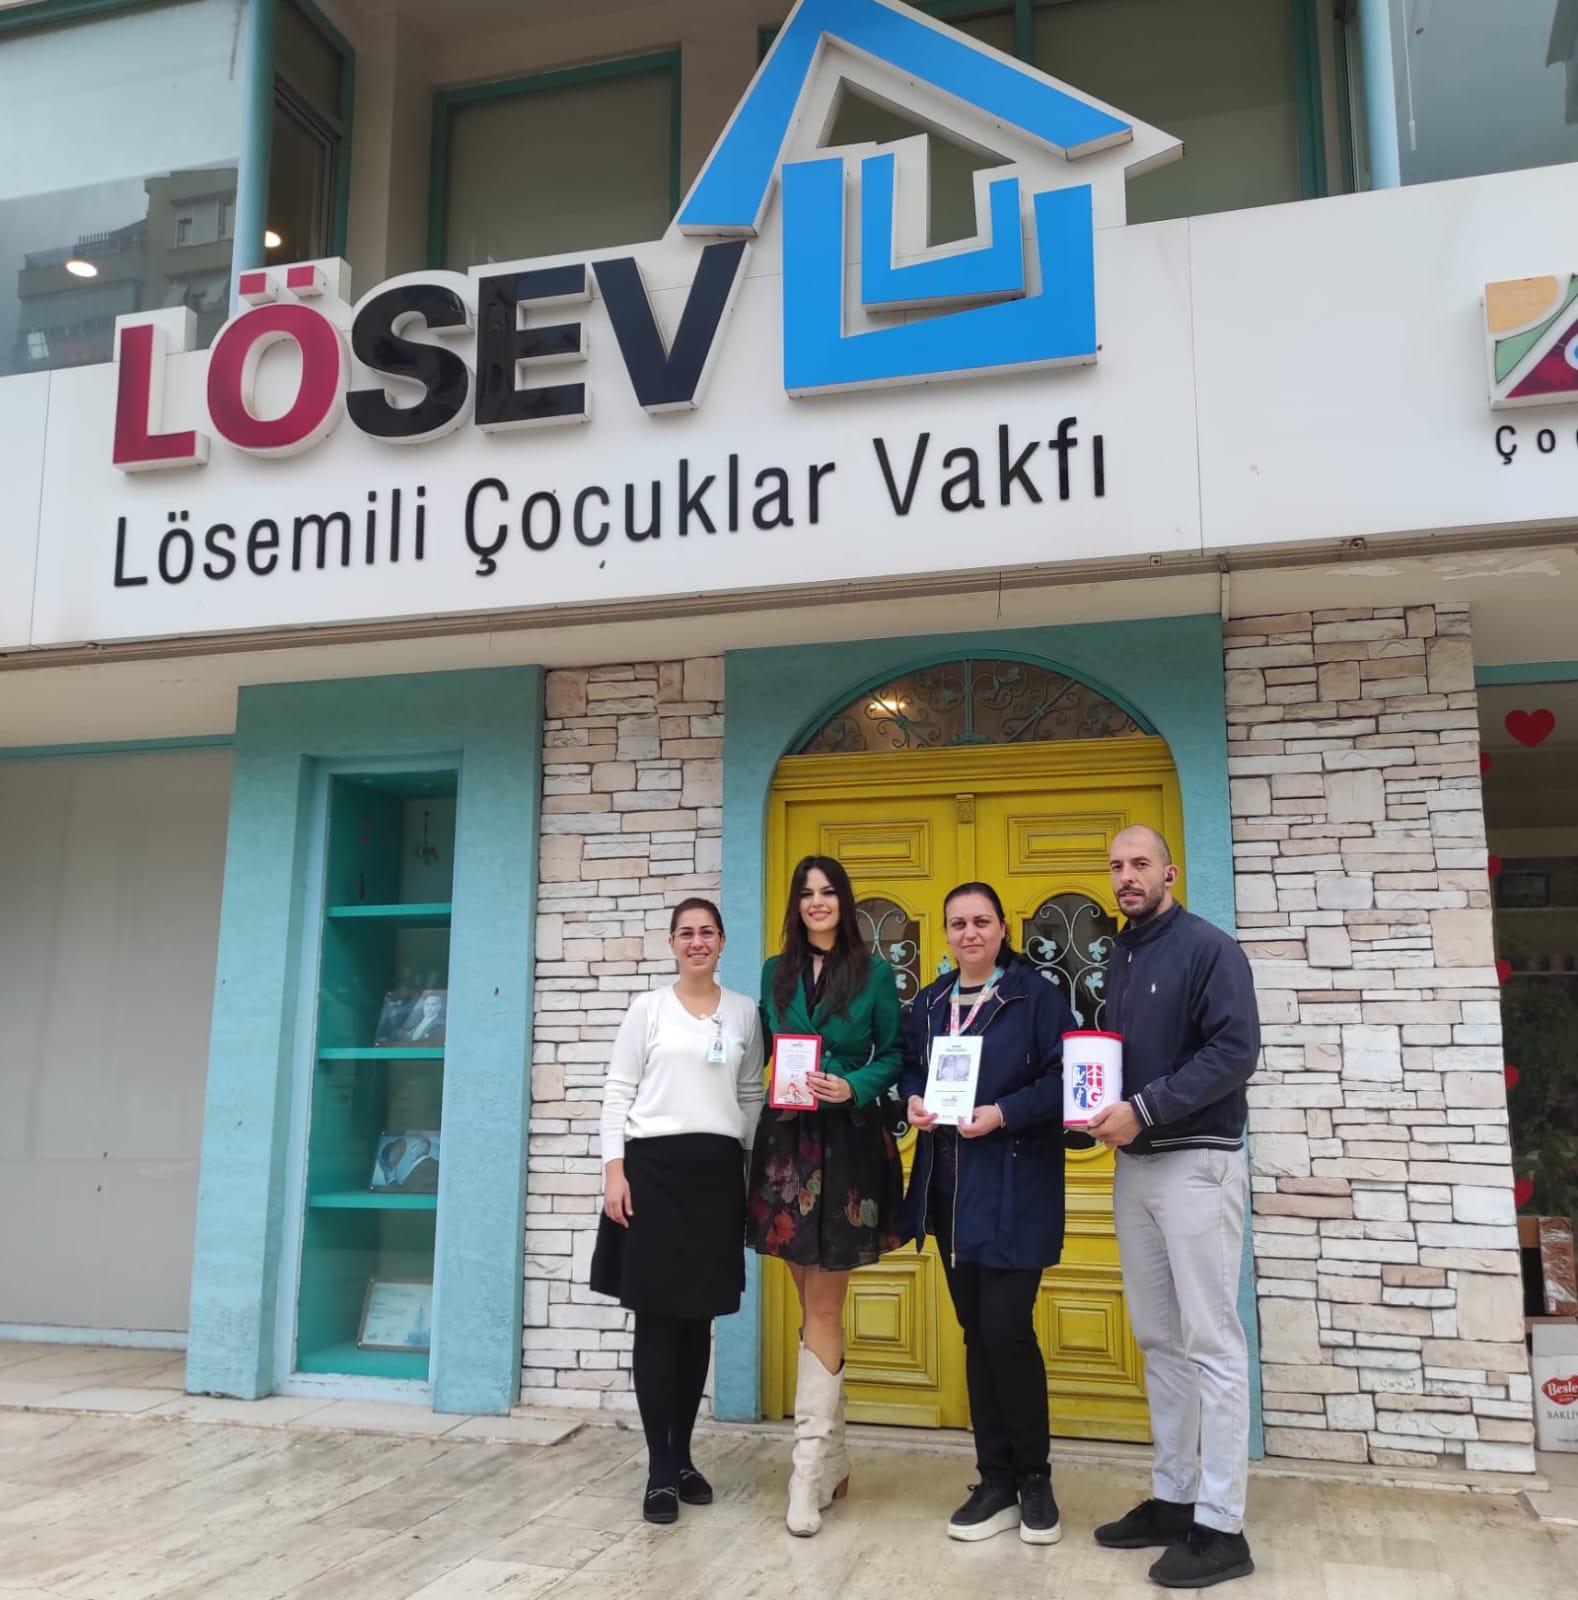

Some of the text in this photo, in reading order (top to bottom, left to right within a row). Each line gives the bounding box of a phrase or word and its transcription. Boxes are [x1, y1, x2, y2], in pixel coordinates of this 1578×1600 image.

[113, 241, 750, 467] LÖSEV
[114, 485, 426, 588] Lösemili
[872, 416, 1106, 517] Vakfı
[1494, 424, 1578, 466] Ço
